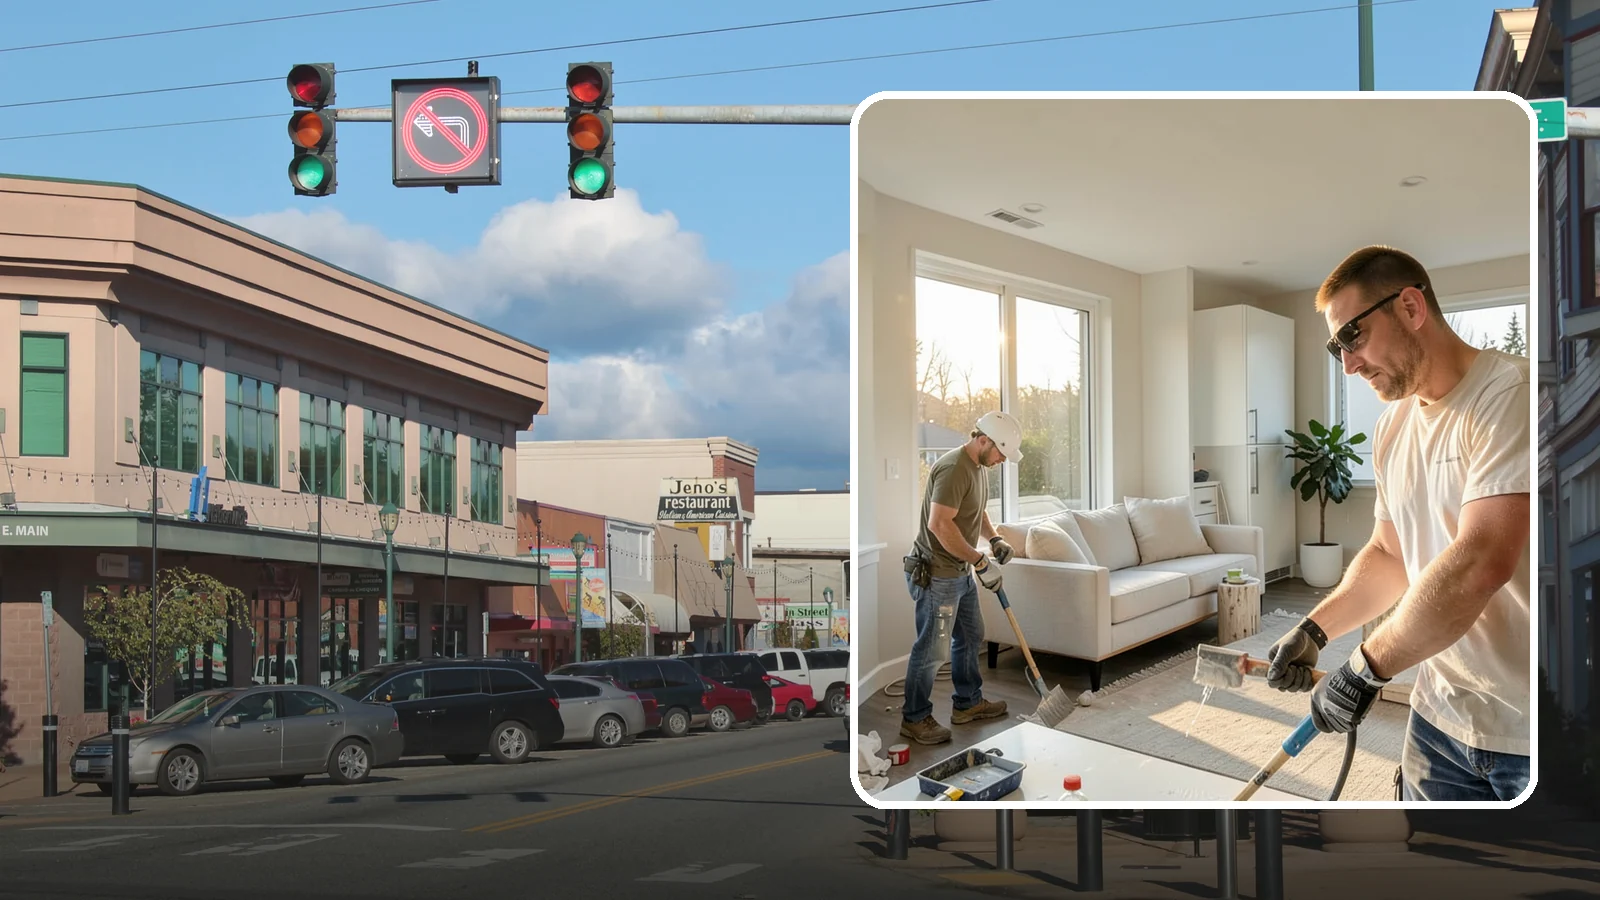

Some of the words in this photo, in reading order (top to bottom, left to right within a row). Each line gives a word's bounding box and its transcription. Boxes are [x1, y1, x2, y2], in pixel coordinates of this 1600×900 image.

[669, 480, 728, 494] Jeno's
[665, 496, 731, 509] restaurant
[715, 509, 737, 519] Cuisine
[2, 525, 13, 536] E.
[15, 525, 49, 536] MAIN
[797, 608, 828, 617] Street
